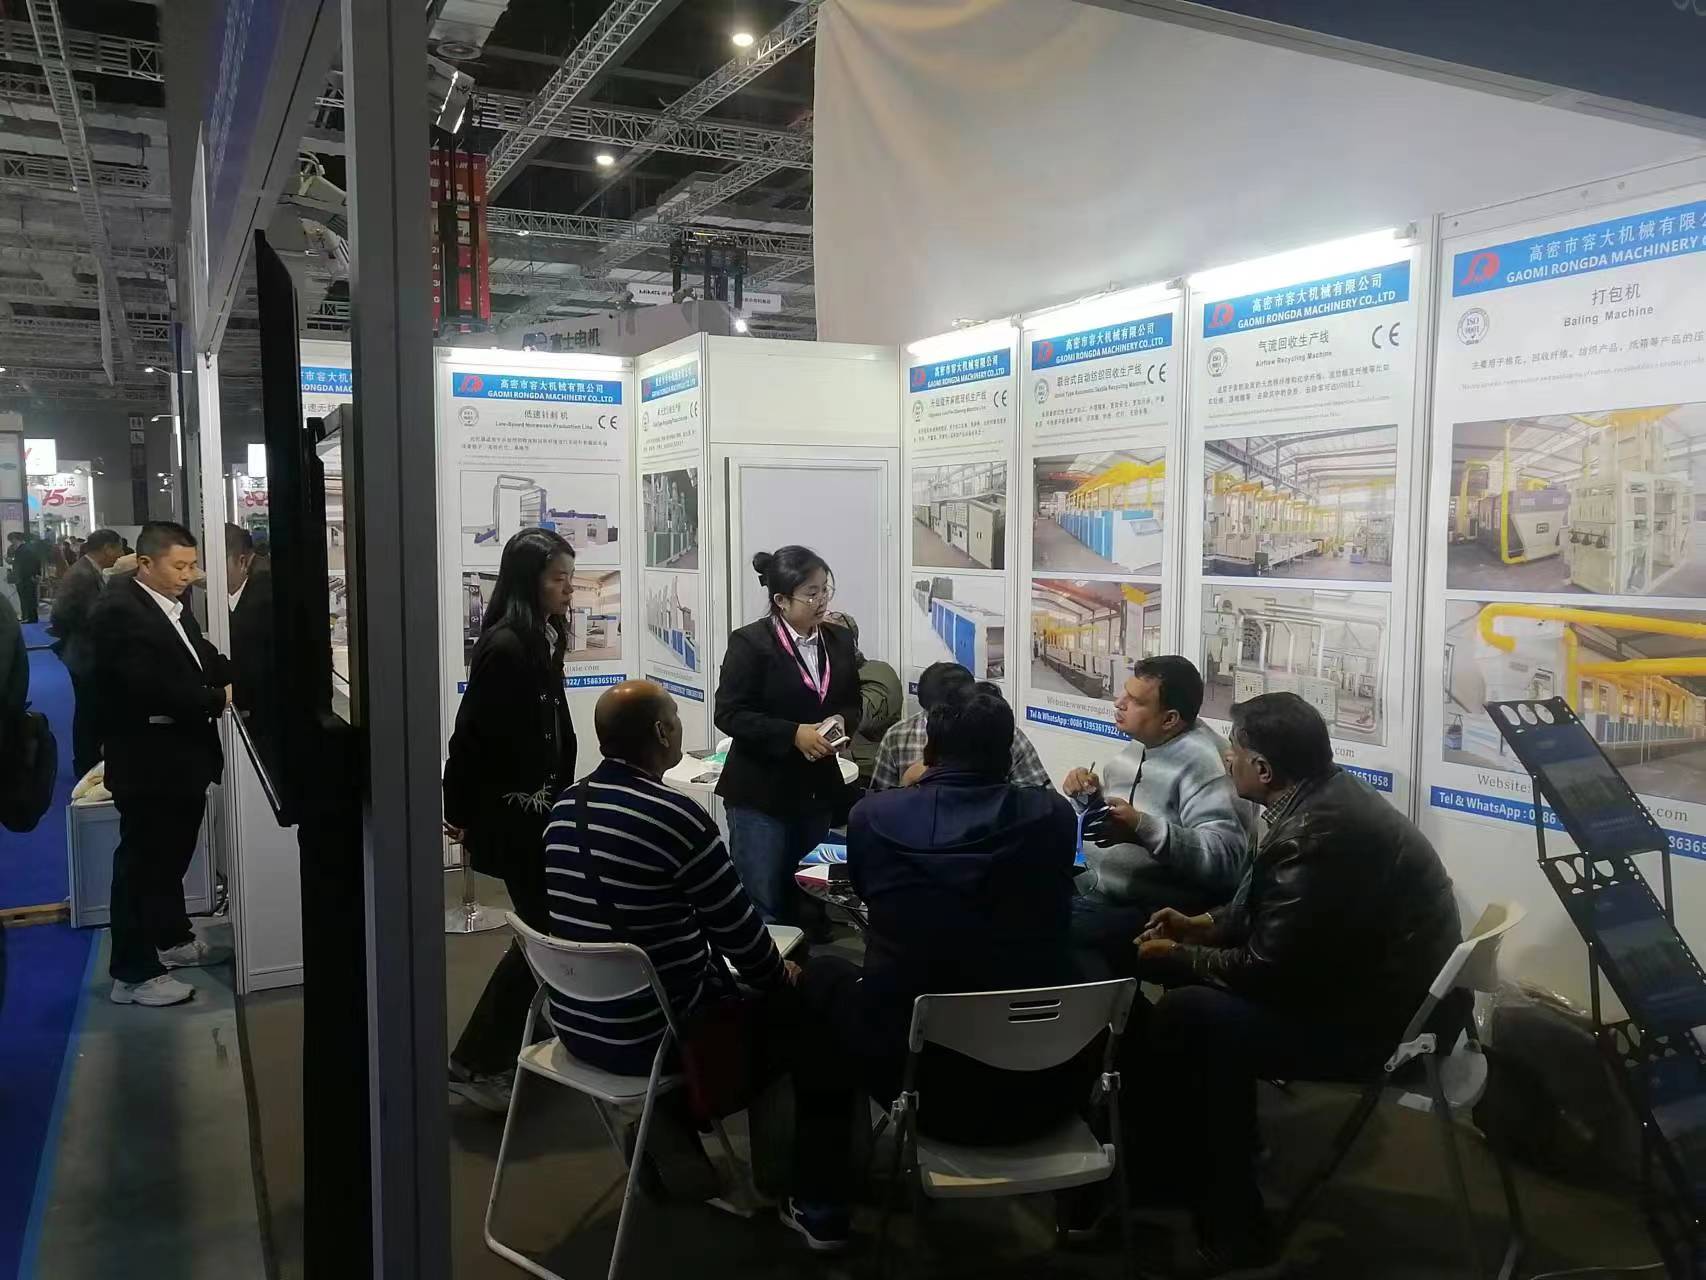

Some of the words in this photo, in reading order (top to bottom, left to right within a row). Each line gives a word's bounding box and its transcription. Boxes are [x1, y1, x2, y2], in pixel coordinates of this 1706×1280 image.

[1507, 267, 1548, 284] GAOMI
[1551, 255, 1607, 275] RONGDA
[1611, 234, 1698, 265] MACHINERY
[1252, 273, 1382, 312] 高密市容大机械有限公司
[1591, 283, 1641, 305] 打包机
[1238, 314, 1265, 329] GAOMI
[1266, 309, 1302, 325] RONGDA
[1303, 299, 1358, 316] MACHINERY
[1563, 314, 1599, 327] Baling
[1604, 305, 1654, 322] Machine
[1065, 322, 1154, 351] 高密市容大机械有限公司
[1258, 329, 1329, 353] 气流回收生产线
[1056, 352, 1075, 364] GAOMI
[1076, 347, 1101, 361] RONGDA
[1101, 342, 1138, 356] MACHINERY
[1277, 353, 1306, 366] Recycling
[1307, 350, 1333, 361] Machine
[487, 390, 513, 398] GAOMI
[513, 390, 544, 400] RONGDA
[545, 393, 587, 402] MACHINERY
[1439, 791, 1453, 804] Tel
[1456, 795, 1464, 806] &
[1466, 797, 1520, 820] WhatsApp
[1528, 811, 1556, 824] 086
